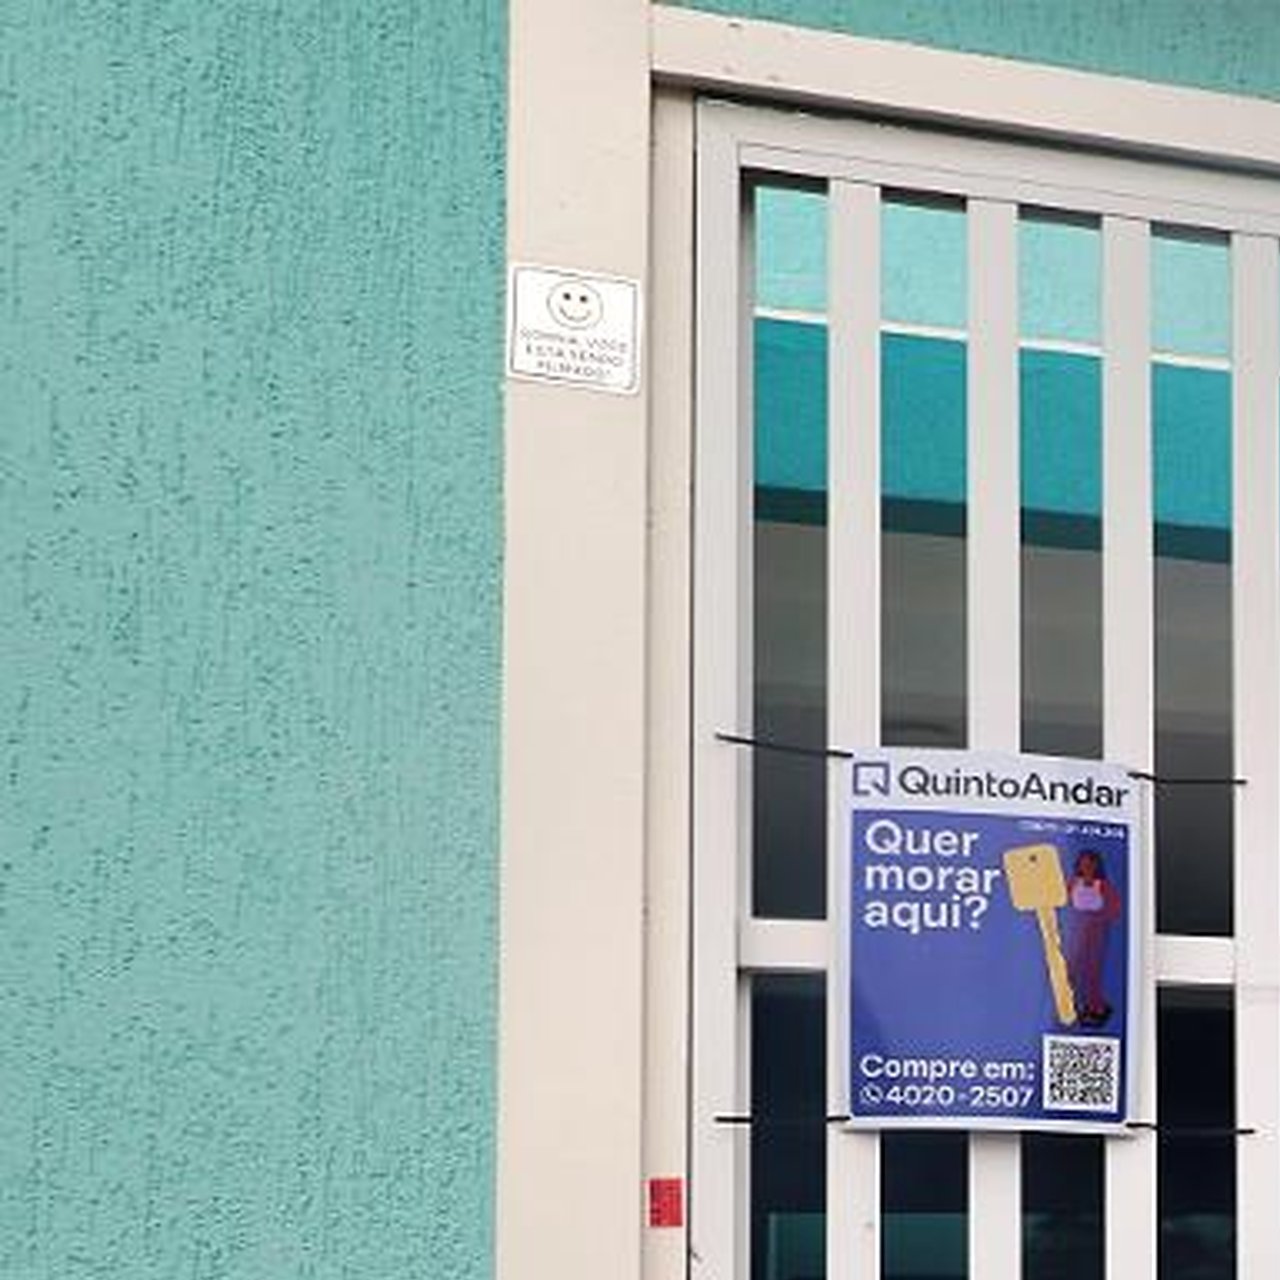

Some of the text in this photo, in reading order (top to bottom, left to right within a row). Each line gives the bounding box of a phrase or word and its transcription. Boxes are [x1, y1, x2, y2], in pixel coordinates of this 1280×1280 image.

[898, 766, 1129, 808] QuintoAndar
[864, 819, 979, 856] Quer
[864, 864, 1001, 894] morar
[864, 894, 989, 934] aqui?
[859, 1054, 1035, 1083] Compre em:
